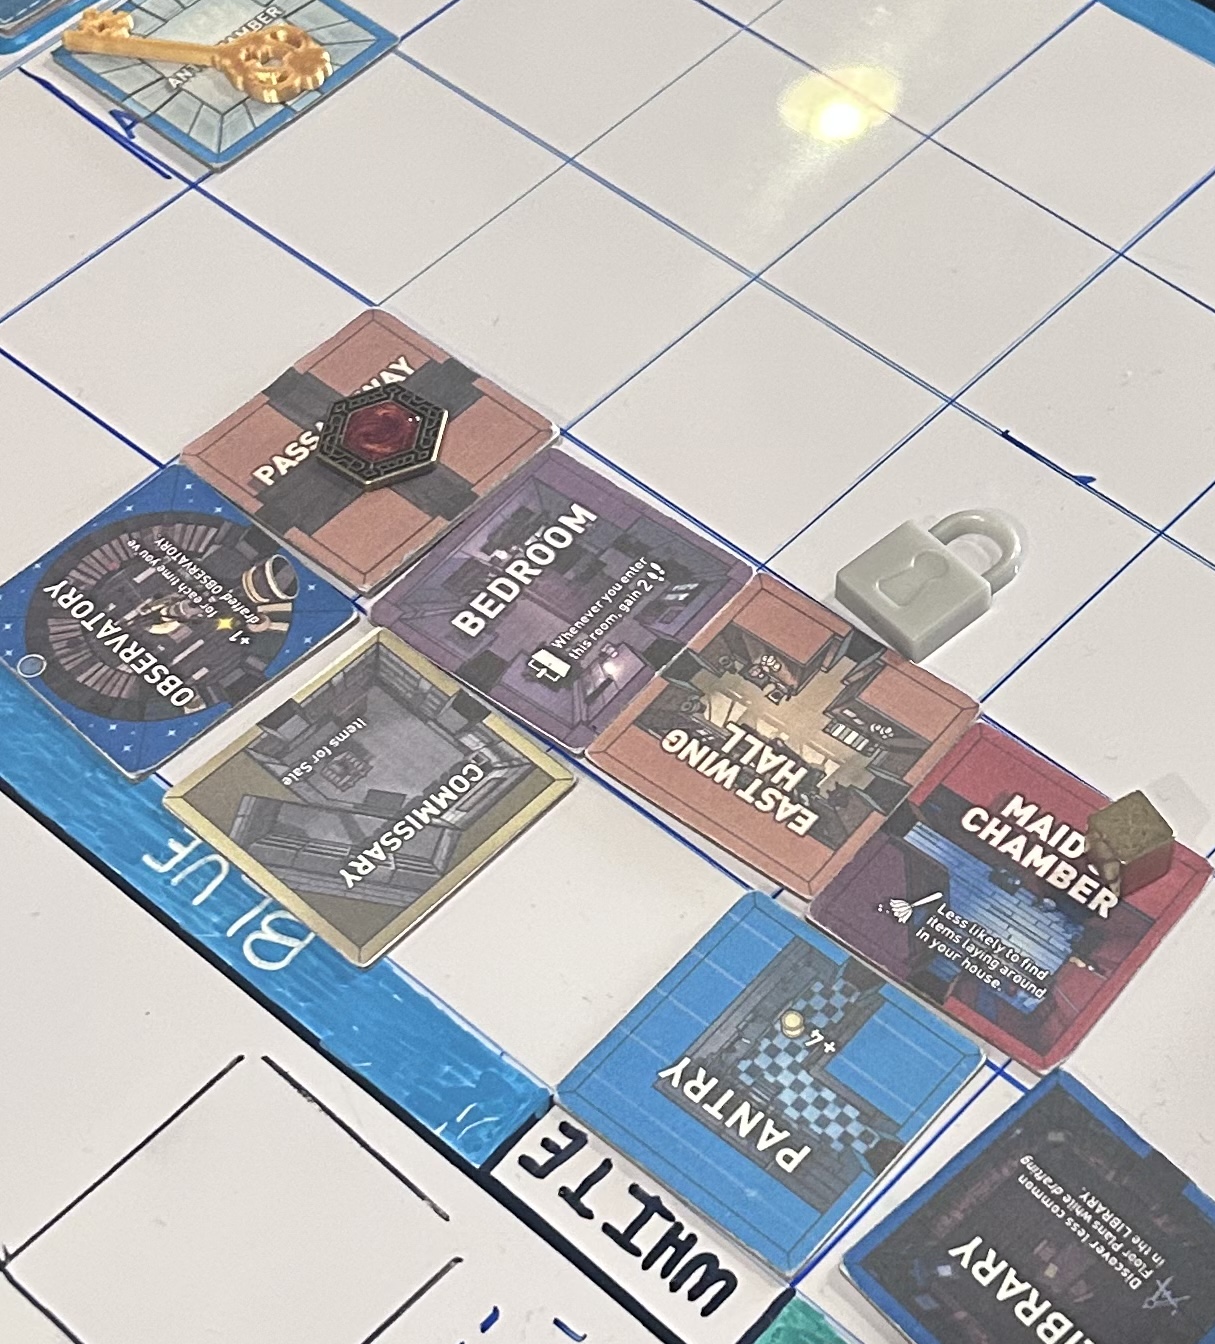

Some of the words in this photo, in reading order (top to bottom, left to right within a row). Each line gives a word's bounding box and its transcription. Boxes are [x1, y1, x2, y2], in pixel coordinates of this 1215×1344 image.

[252, 356, 415, 487] PASSWAY
[156, 564, 180, 586] time
[178, 582, 203, 604] each
[451, 502, 598, 637] BEDROOM
[200, 603, 218, 618] for
[220, 592, 260, 624] drafted
[551, 600, 604, 649] Whenever
[601, 582, 623, 604] you
[621, 556, 648, 584] enter
[568, 640, 592, 660] this
[589, 613, 623, 641] room,
[618, 589, 642, 613] gain
[637, 579, 653, 592] 2
[43, 580, 196, 707] OBSERVATORY
[228, 630, 251, 645] +1
[311, 746, 332, 764] for
[329, 717, 367, 747] Items
[281, 761, 313, 786] Sale
[661, 728, 738, 790] WING
[726, 721, 808, 793] HALL
[339, 762, 485, 889] COMMISSARY
[736, 780, 819, 837] EAST
[960, 806, 1119, 919] CHAMBER
[915, 926, 930, 942] in
[928, 938, 962, 961] your
[960, 957, 1002, 992] house.
[926, 915, 962, 944] items
[961, 937, 1000, 970] laying
[999, 965, 1047, 999] around
[937, 902, 969, 929] Less
[968, 923, 1006, 954] likely
[1005, 947, 1020, 963] to
[1020, 958, 1050, 981] find
[803, 1028, 837, 1055] +4
[657, 1056, 812, 1174] PANTRY
[1017, 1174, 1066, 1219] common
[1019, 1155, 1064, 1195] drafting
[519, 1120, 739, 1318] WHITE
[1062, 1194, 1093, 1223] while
[1064, 1216, 1090, 1243] less
[1078, 1187, 1132, 1238] LIBRARY.
[1091, 1220, 1124, 1252] Plans
[1131, 1234, 1152, 1256] the
[1089, 1240, 1142, 1290] Discover
[1121, 1249, 1154, 1279] Floor
[1151, 1252, 1166, 1268] in
